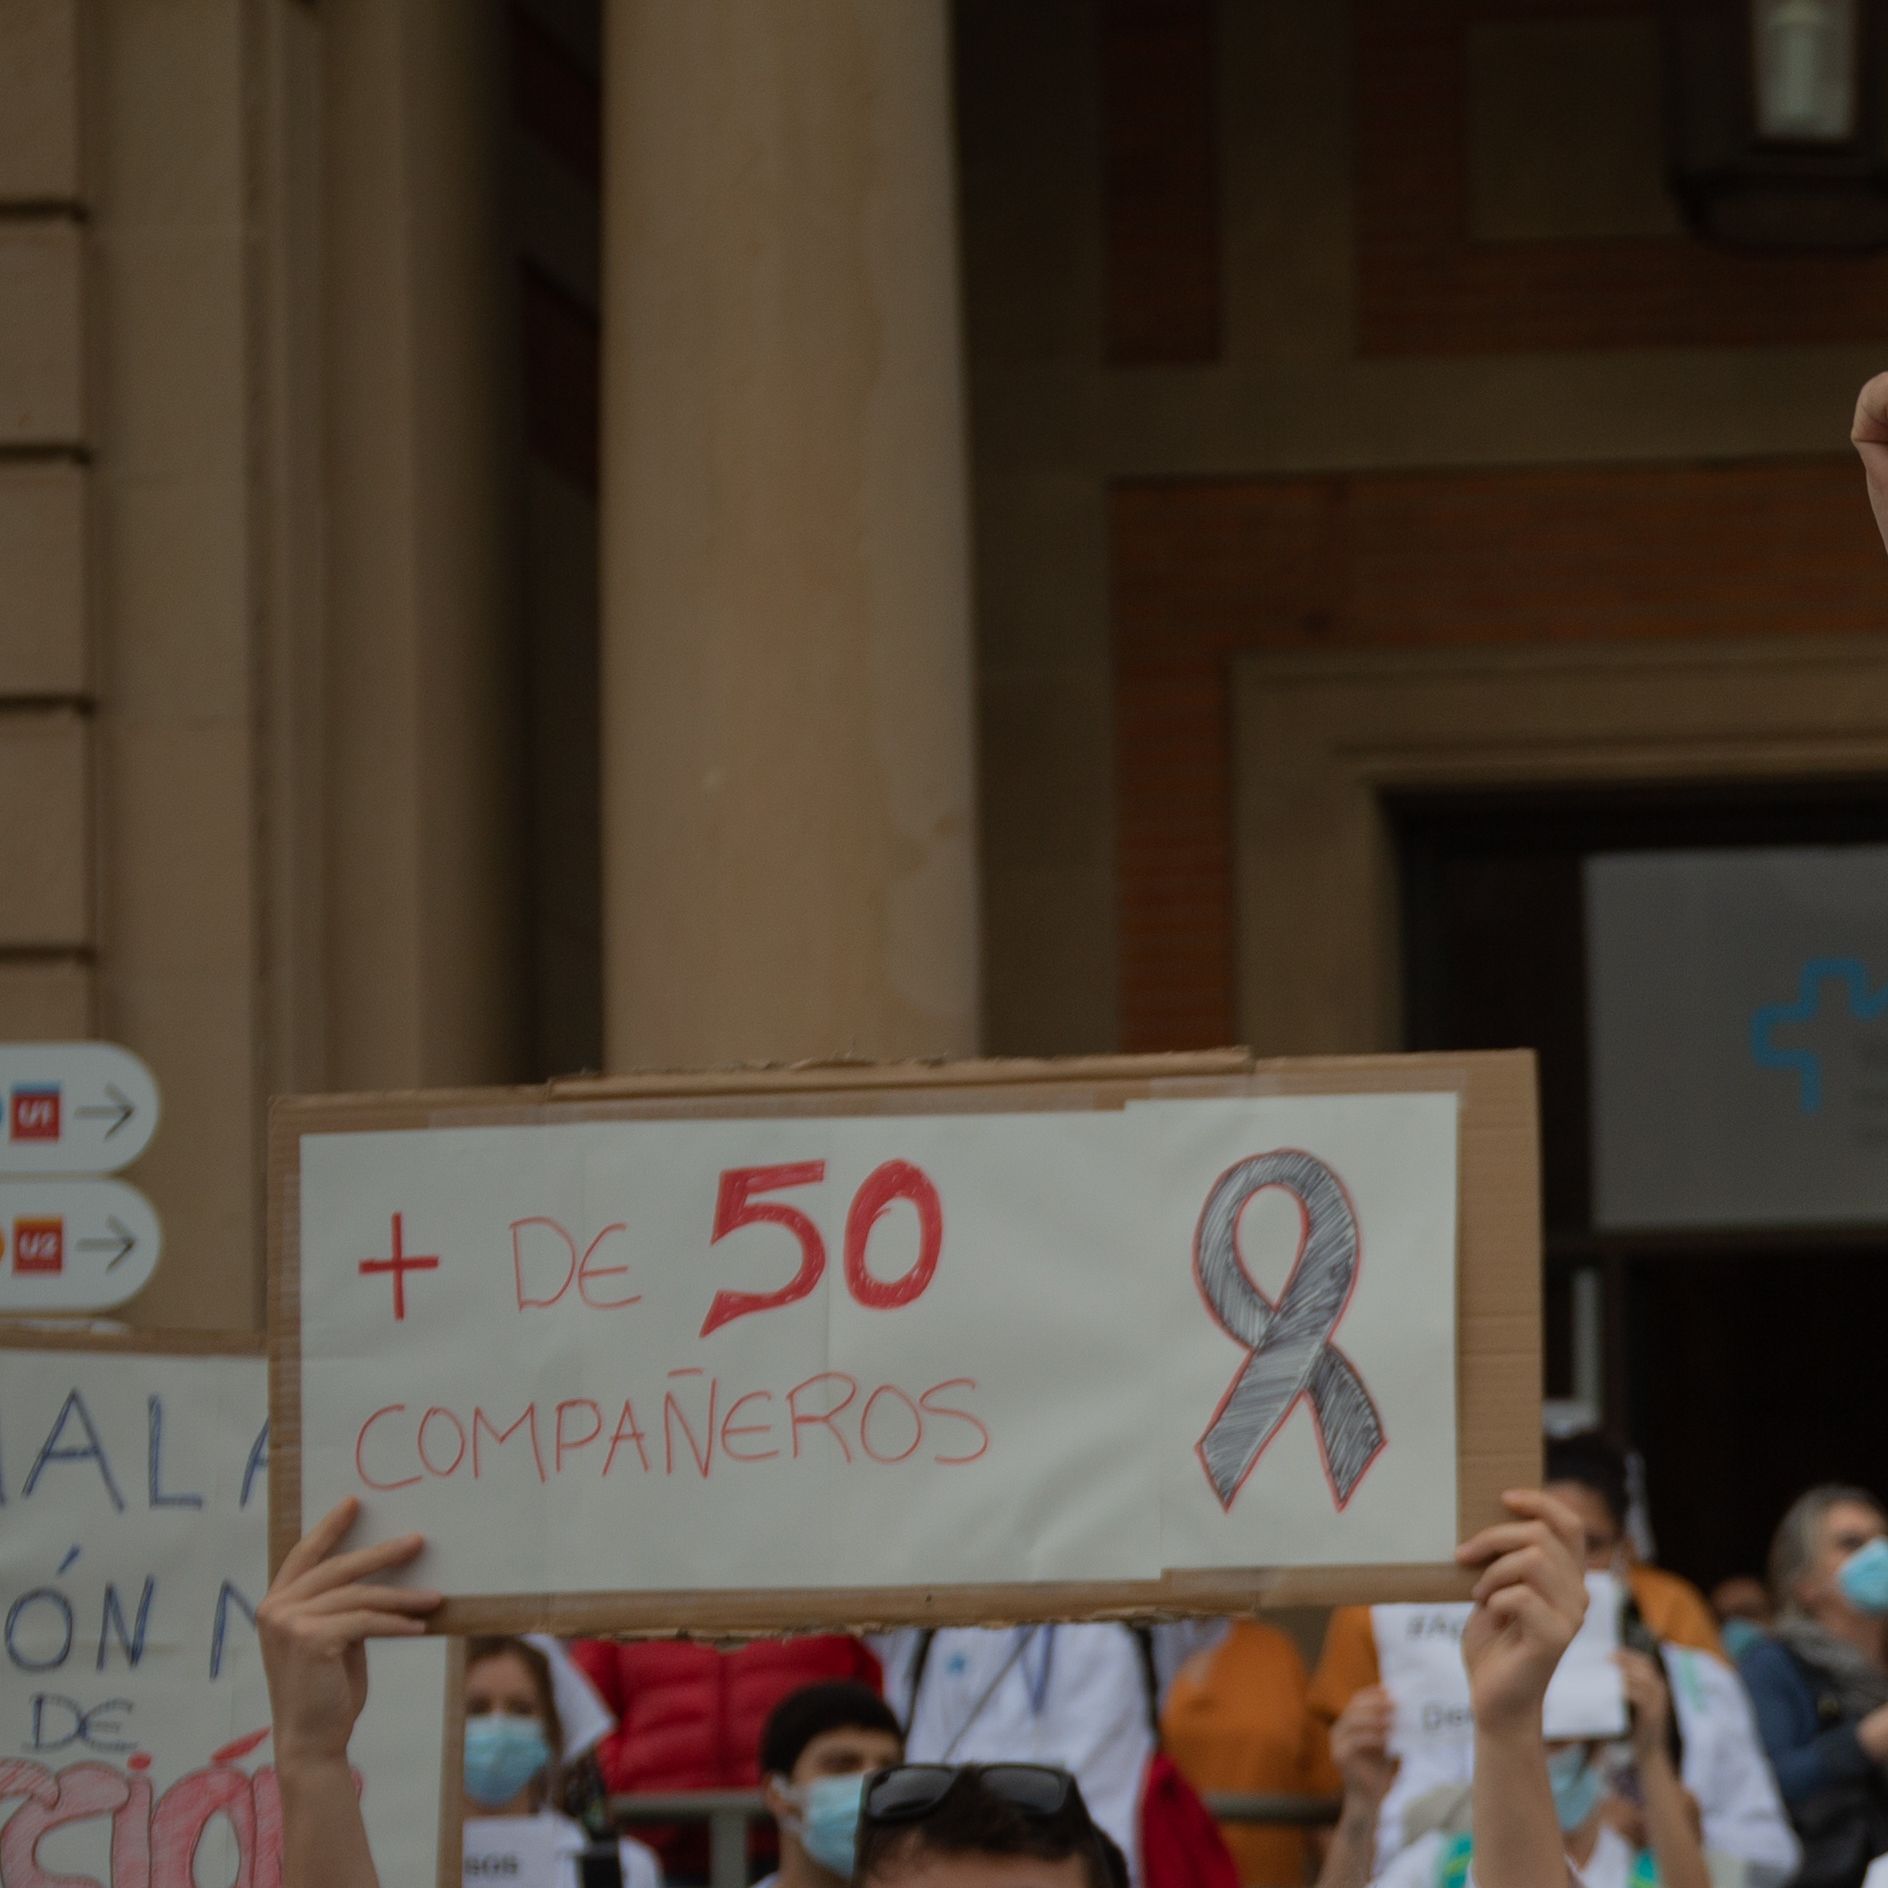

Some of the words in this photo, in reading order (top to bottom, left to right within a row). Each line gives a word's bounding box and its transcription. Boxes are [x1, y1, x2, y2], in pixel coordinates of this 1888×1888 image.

[509, 1216, 642, 1312] DE
[699, 1158, 943, 1338] 50
[355, 1367, 990, 1490] COMPAÑEROS
